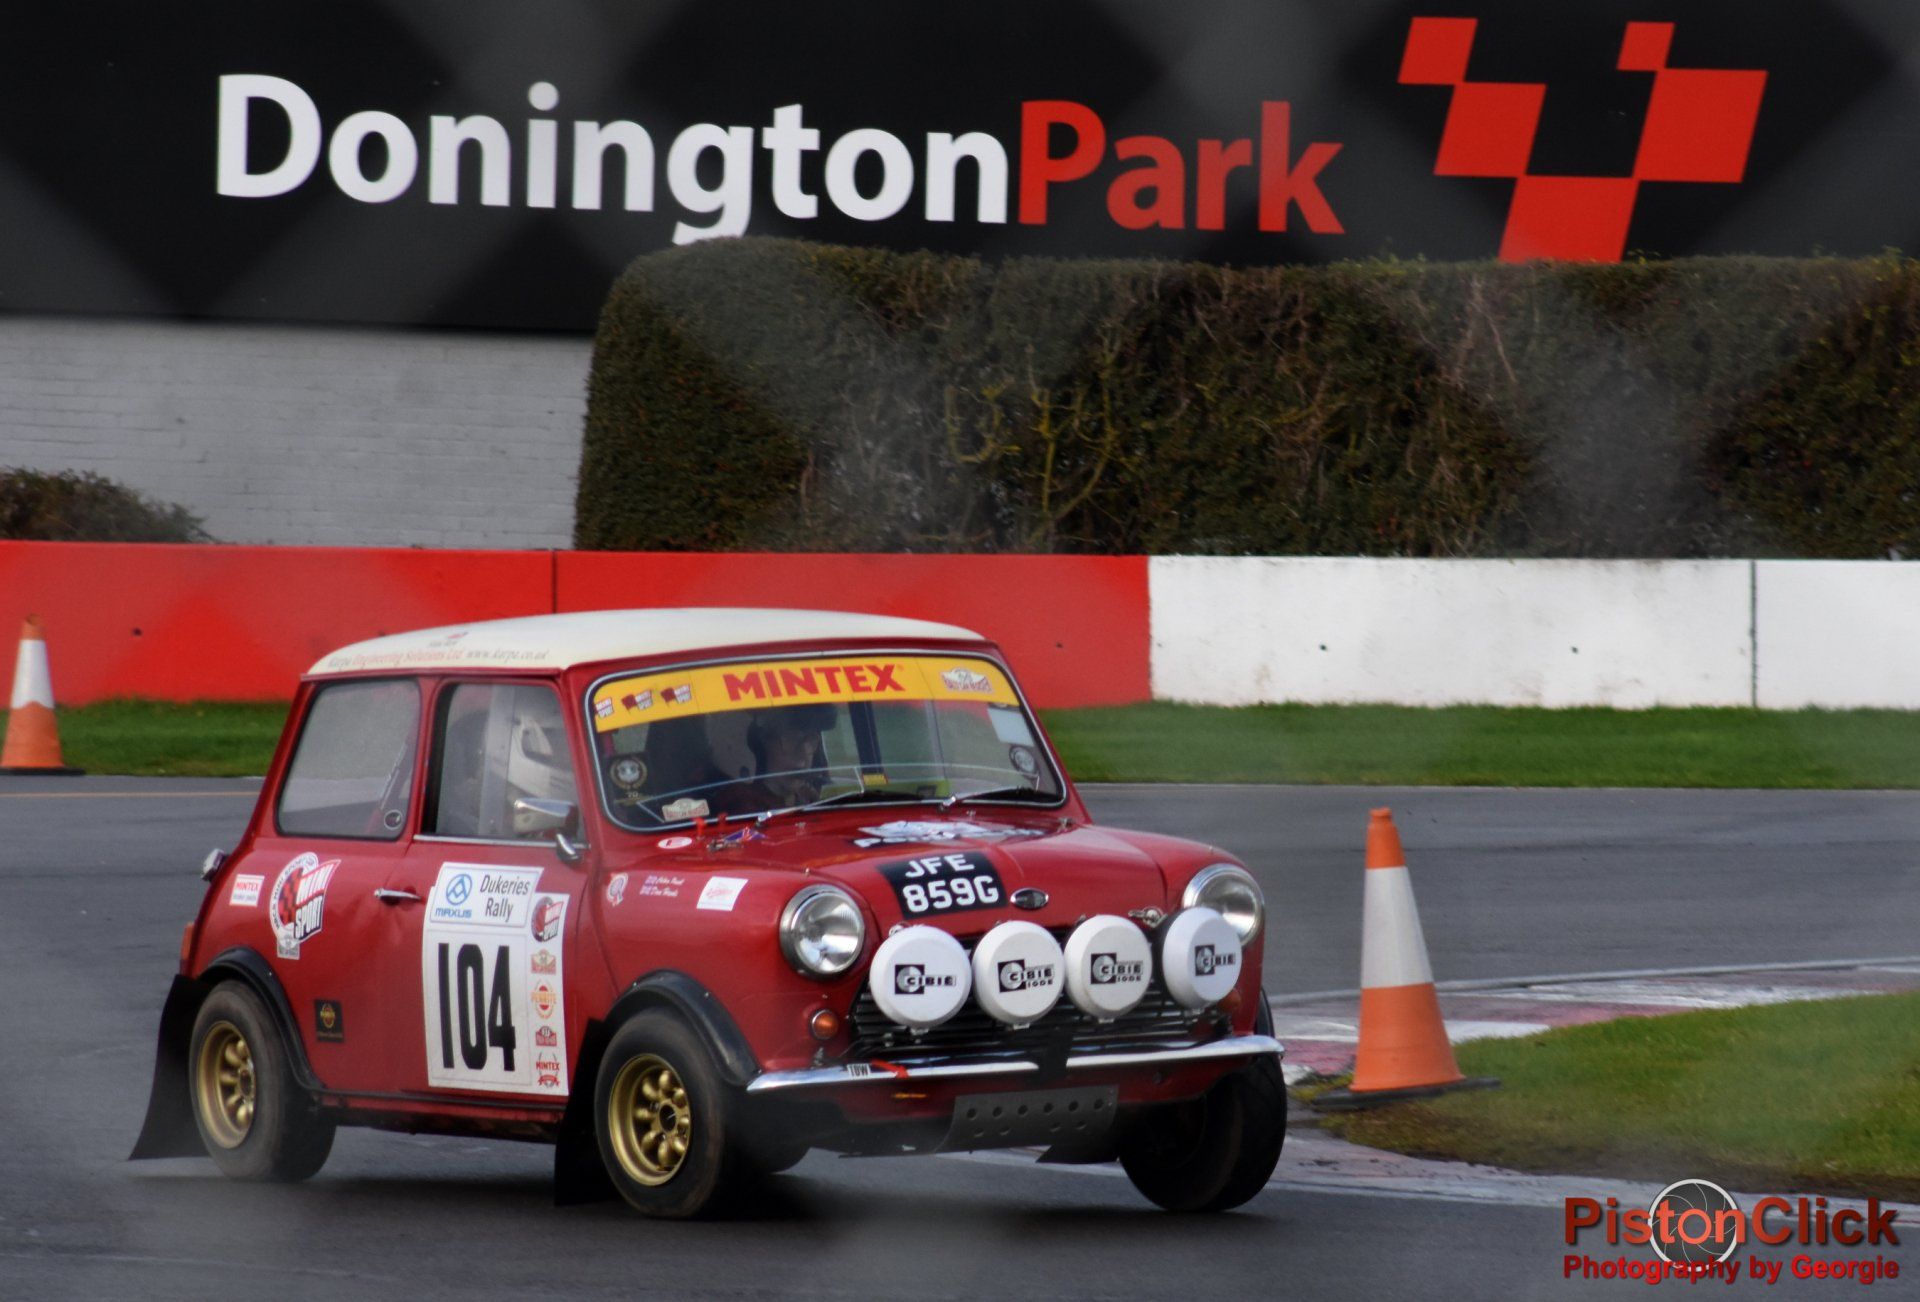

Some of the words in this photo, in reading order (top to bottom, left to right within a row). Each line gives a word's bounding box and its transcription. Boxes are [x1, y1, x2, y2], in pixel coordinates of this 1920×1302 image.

[722, 664, 905, 701] MINTEX
[905, 853, 975, 878] JFE
[296, 863, 335, 904] MINI
[480, 874, 530, 896] Dukeries
[902, 875, 999, 913] 859G
[295, 894, 323, 939] SPORT
[435, 908, 472, 918] MAXUS
[485, 897, 513, 922] Rally
[1101, 964, 1141, 975] CIBIE
[1202, 953, 1235, 967] CIBIE
[906, 975, 954, 986] CIBIE
[1010, 967, 1052, 981] CIBIE
[438, 943, 516, 1071] 104
[535, 1061, 560, 1071] MINTEX
[850, 1064, 870, 1077] TOW
